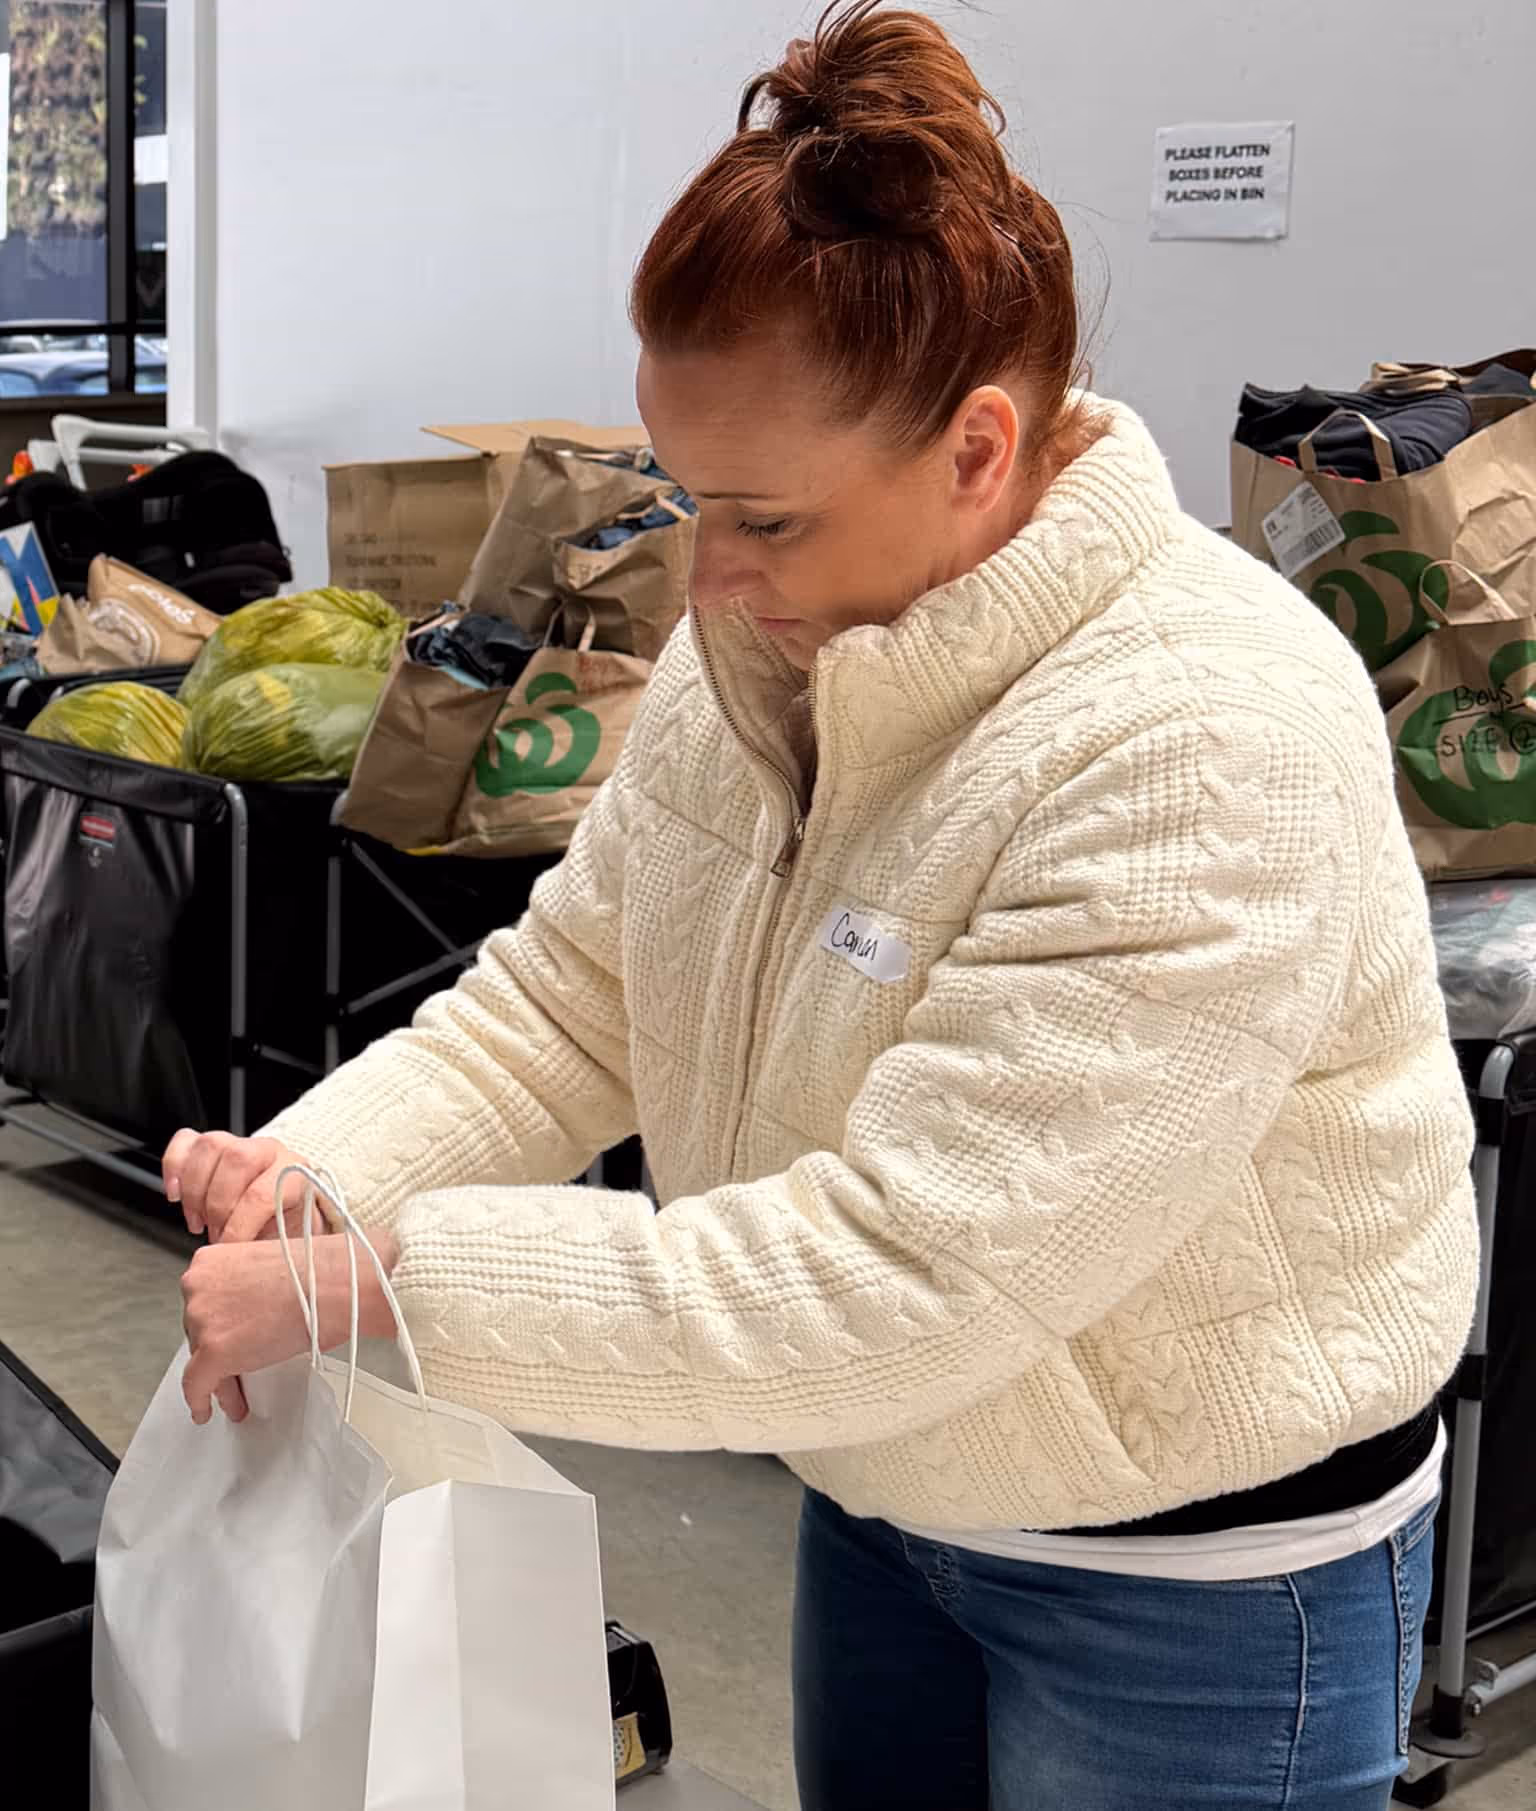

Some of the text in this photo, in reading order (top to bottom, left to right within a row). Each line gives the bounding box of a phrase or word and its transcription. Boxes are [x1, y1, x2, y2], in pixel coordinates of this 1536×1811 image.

[1165, 144, 1270, 160] PLEASE FLATTEN
[1169, 166, 1263, 181] BOXES BEFORE
[1165, 187, 1264, 202] PLACING IN BIN
[1454, 684, 1513, 714] Boys
